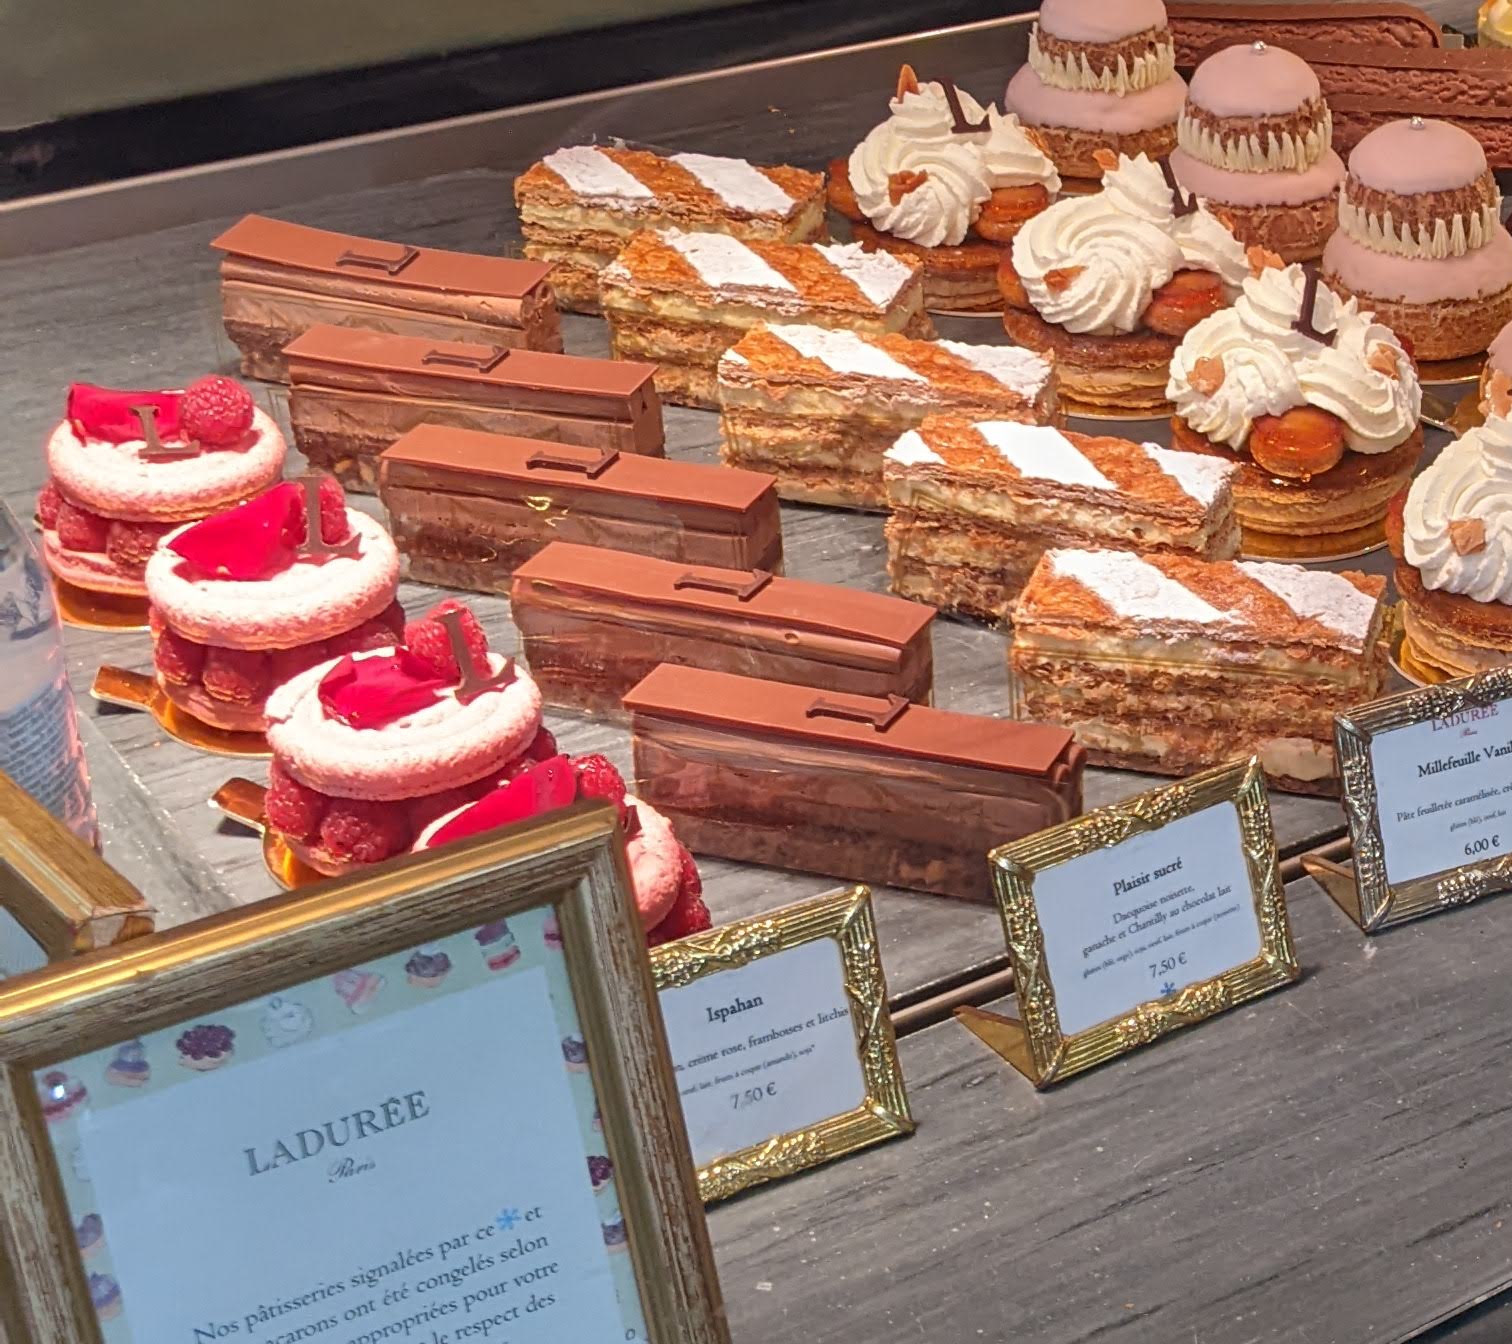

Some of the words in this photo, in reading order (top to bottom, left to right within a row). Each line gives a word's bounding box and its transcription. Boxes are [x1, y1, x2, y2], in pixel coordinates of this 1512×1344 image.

[1418, 751, 1480, 777] Millefeuille
[1397, 812, 1414, 822] Pâte
[1465, 838, 1489, 855] 6,00
[1492, 835, 1500, 847] €
[1113, 874, 1150, 896] Plaisir
[1154, 857, 1182, 879] sucré
[1083, 935, 1116, 958] ganache
[1118, 931, 1126, 939] et
[1128, 912, 1167, 933] Chantilly
[1182, 892, 1216, 912] chocolat
[1149, 957, 1175, 978] 7,50
[1178, 952, 1187, 964] €
[706, 997, 763, 1022] Ispahan
[688, 1052, 718, 1067] crème
[721, 1044, 746, 1056] rose,
[749, 1024, 803, 1048] framboises
[806, 1020, 815, 1028] et
[767, 1082, 776, 1095] €
[243, 1090, 429, 1176] LADURÉE
[328, 1157, 376, 1184] Paris
[244, 1282, 345, 1333] pâtisseries
[351, 1248, 434, 1288] signalées
[438, 1234, 469, 1261] par
[475, 1226, 494, 1240] ce
[525, 1207, 542, 1221] et
[344, 1300, 376, 1320] ont
[383, 1282, 409, 1306] été
[416, 1254, 495, 1293] congelés
[500, 1237, 548, 1262] selon
[463, 1282, 508, 1313] pour
[513, 1263, 558, 1287] votre
[455, 1307, 520, 1340] respect
[525, 1294, 555, 1313] des
